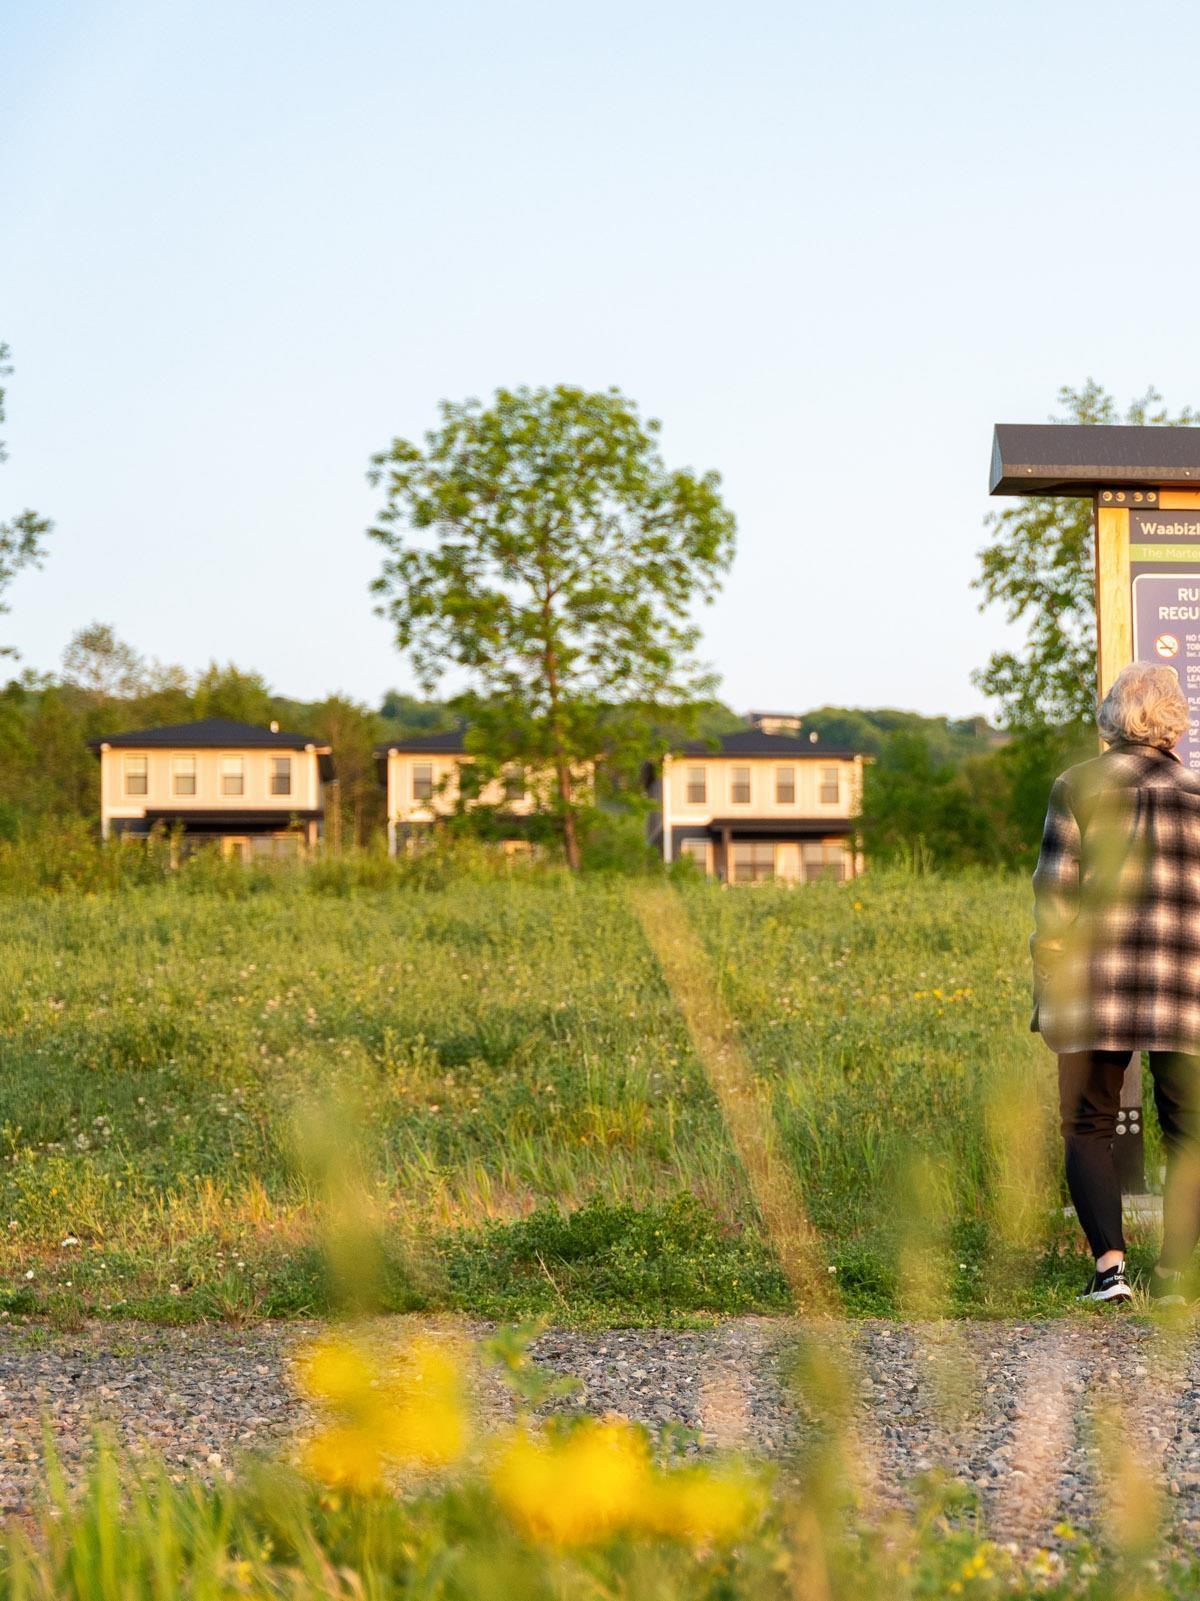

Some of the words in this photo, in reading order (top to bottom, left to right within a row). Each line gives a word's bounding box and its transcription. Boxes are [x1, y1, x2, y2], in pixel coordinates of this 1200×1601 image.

[1142, 548, 1161, 558] The
[1185, 634, 1197, 642] NO
[1188, 728, 1199, 736] OF
